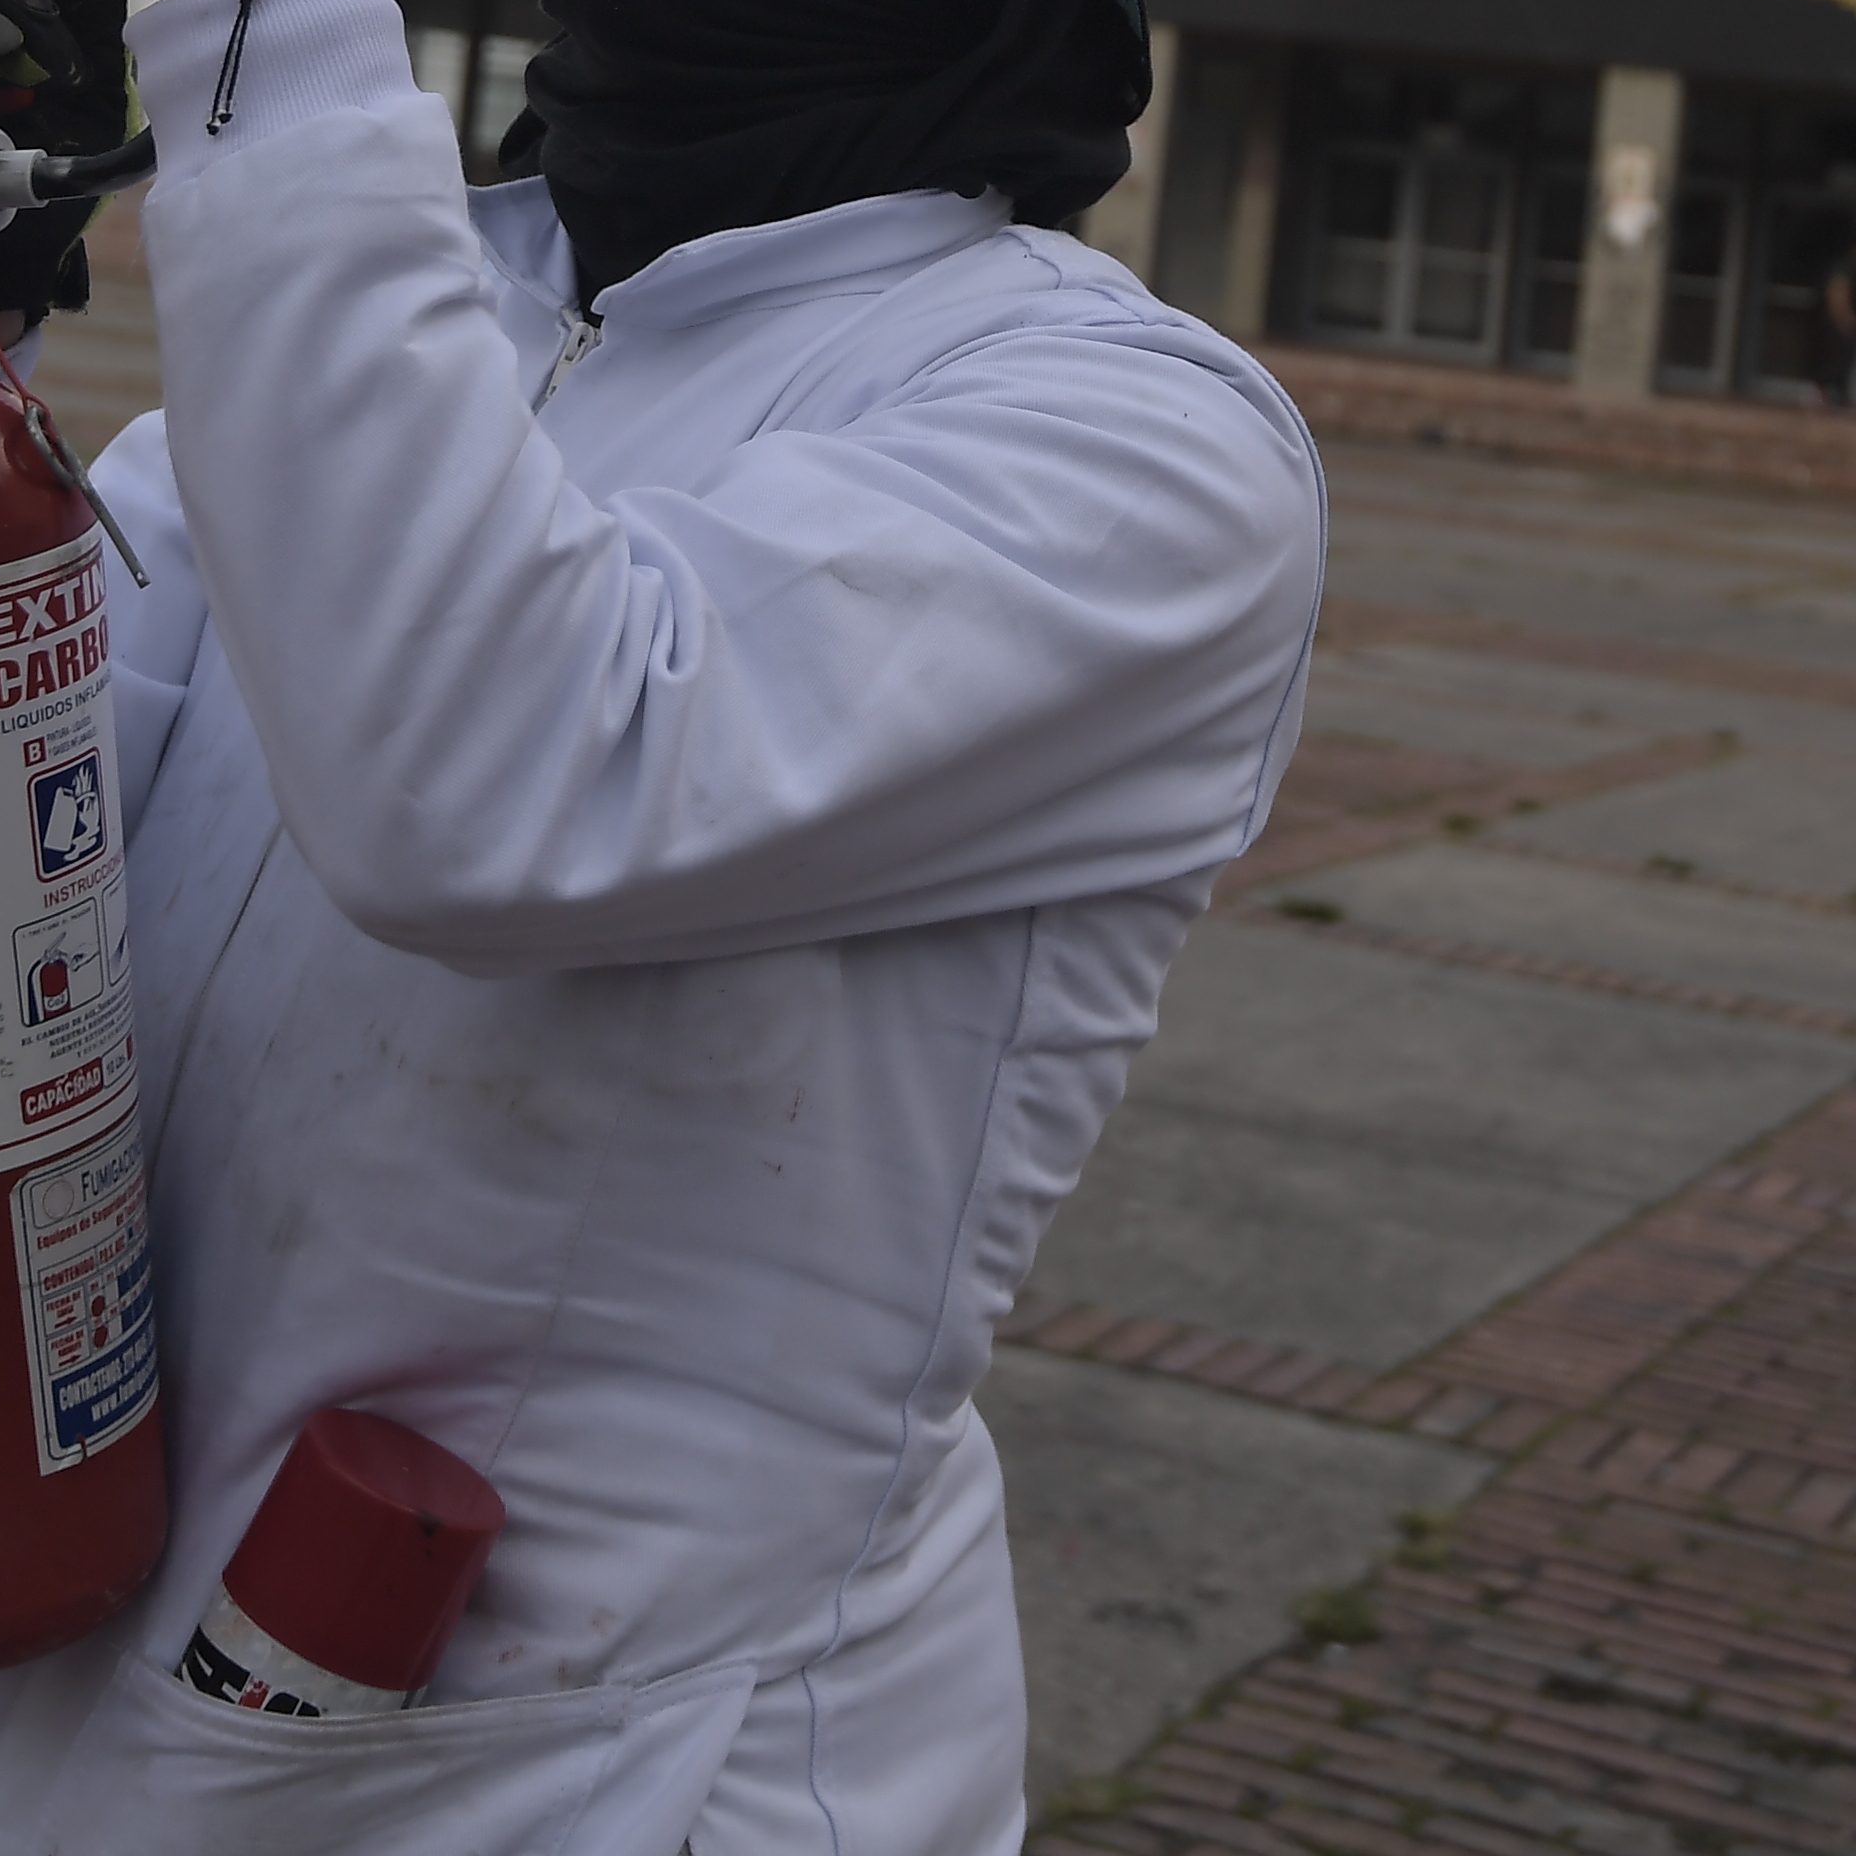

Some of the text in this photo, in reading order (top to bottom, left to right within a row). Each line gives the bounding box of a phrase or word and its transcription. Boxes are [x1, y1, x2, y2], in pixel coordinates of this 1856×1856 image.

[1, 696, 74, 735] LIQUIDOS
[28, 742, 41, 763] B
[25, 1067, 102, 1116] CAPACIDAD
